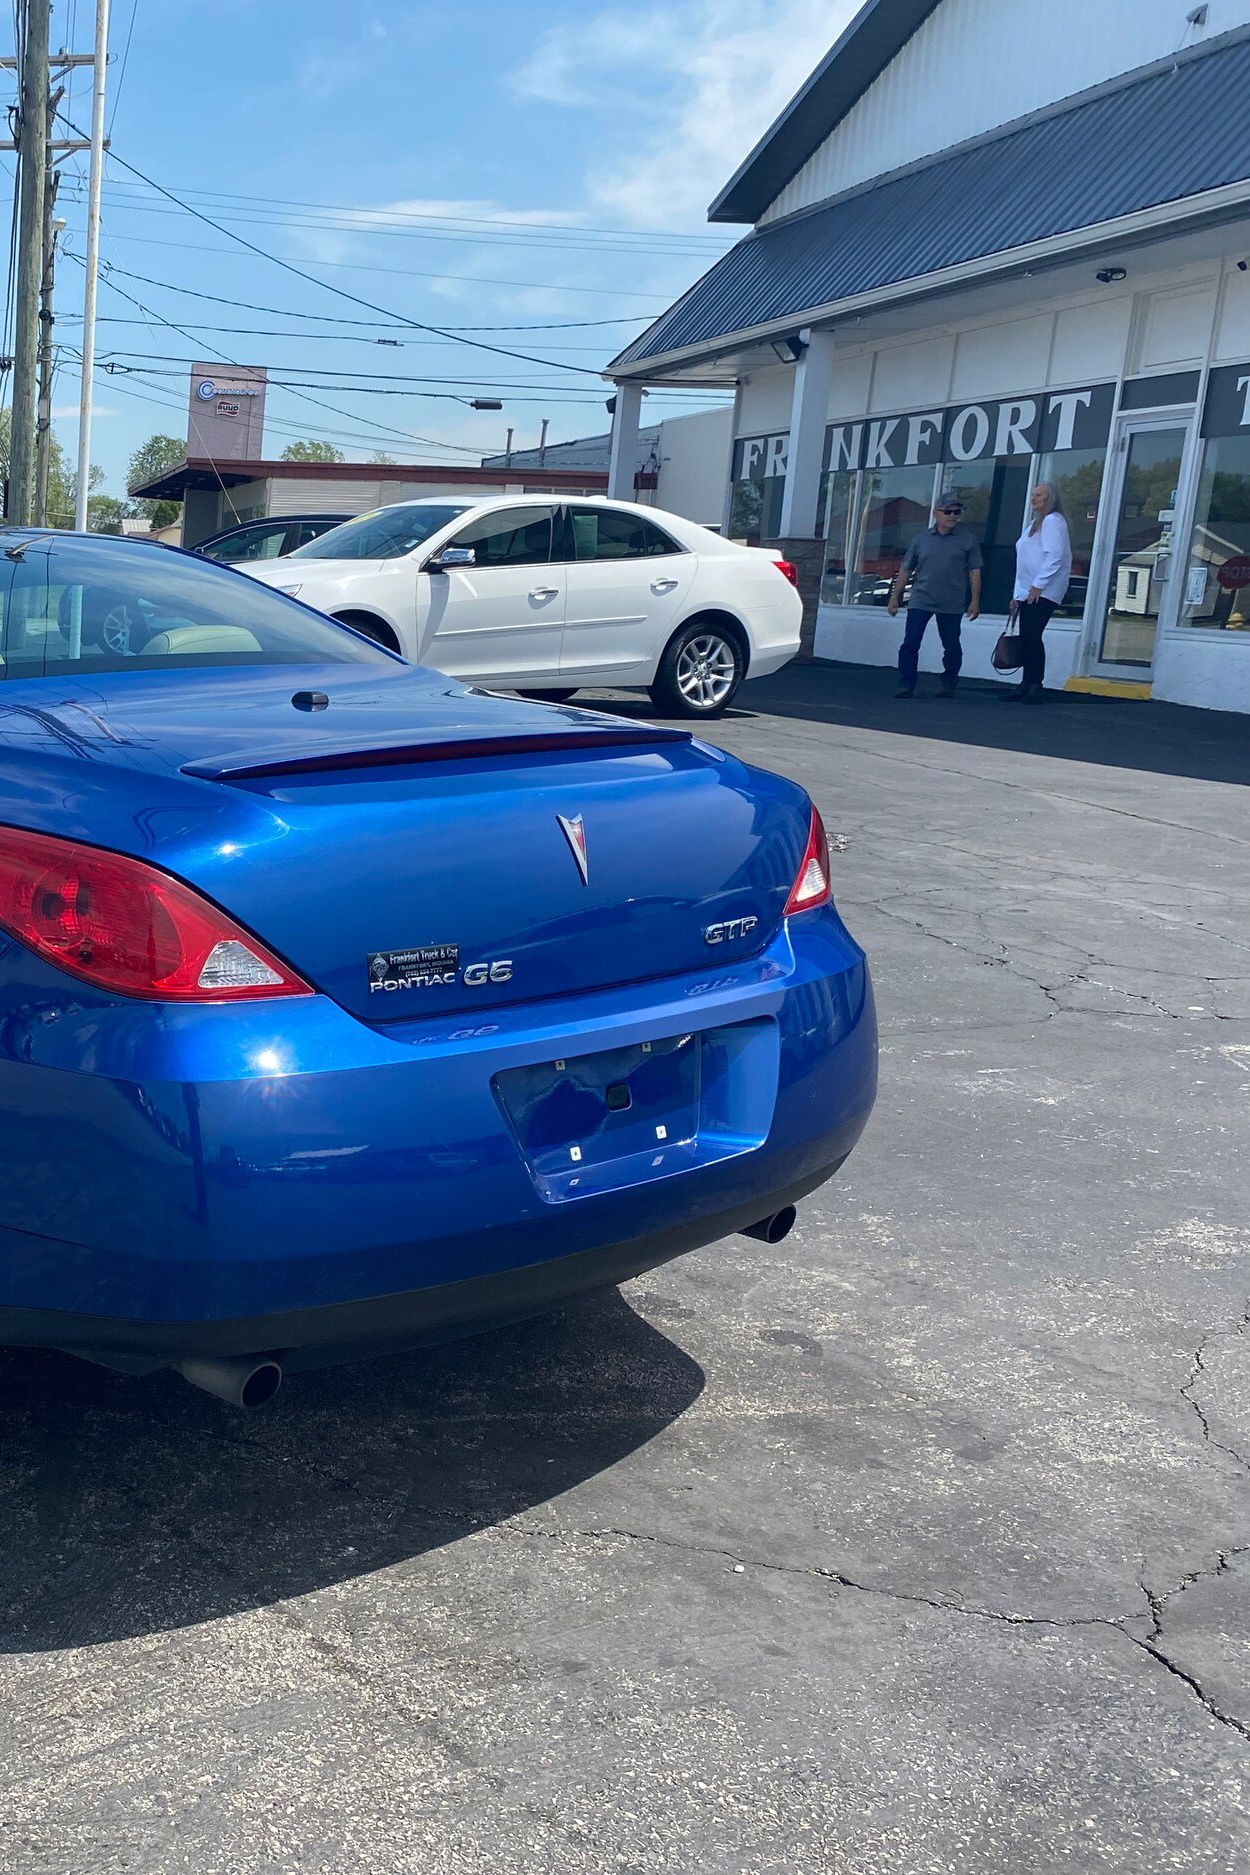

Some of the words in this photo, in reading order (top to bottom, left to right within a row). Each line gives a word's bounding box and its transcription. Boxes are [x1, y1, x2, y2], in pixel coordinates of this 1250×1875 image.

[740, 391, 1091, 480] FRNKFORT
[705, 916, 758, 944] GTP
[369, 972, 456, 993] PONTIAC
[464, 960, 513, 986] G6
